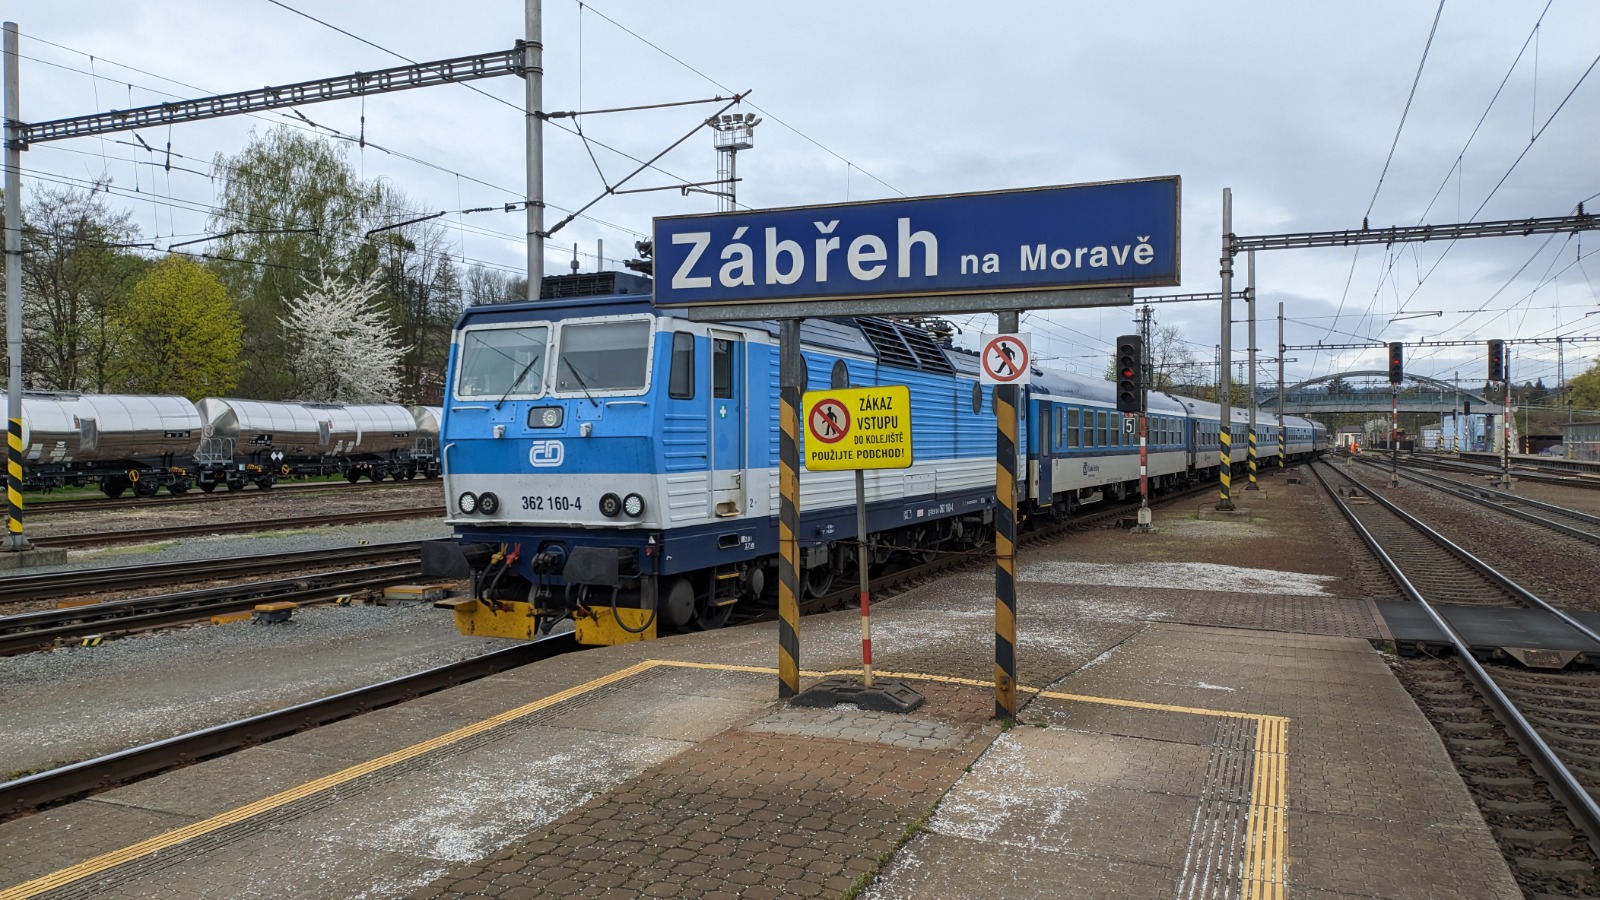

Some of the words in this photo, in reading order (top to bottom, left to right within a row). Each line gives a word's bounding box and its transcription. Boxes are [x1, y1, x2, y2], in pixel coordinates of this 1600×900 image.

[671, 217, 938, 290] Zábřeh
[961, 253, 1000, 275] na
[1020, 235, 1155, 272] Moravě
[859, 394, 893, 412] ZÁKAZ
[857, 415, 898, 430] VSTUPU
[1126, 419, 1133, 433] 5
[854, 435, 864, 445] DO
[865, 431, 904, 444] KOLEJIŠTĚ
[811, 448, 853, 461] POUŽIJTE
[856, 448, 904, 459] PODCHOD!
[521, 495, 544, 511] 362
[547, 496, 582, 511] 160-4
[749, 498, 754, 508] 2
